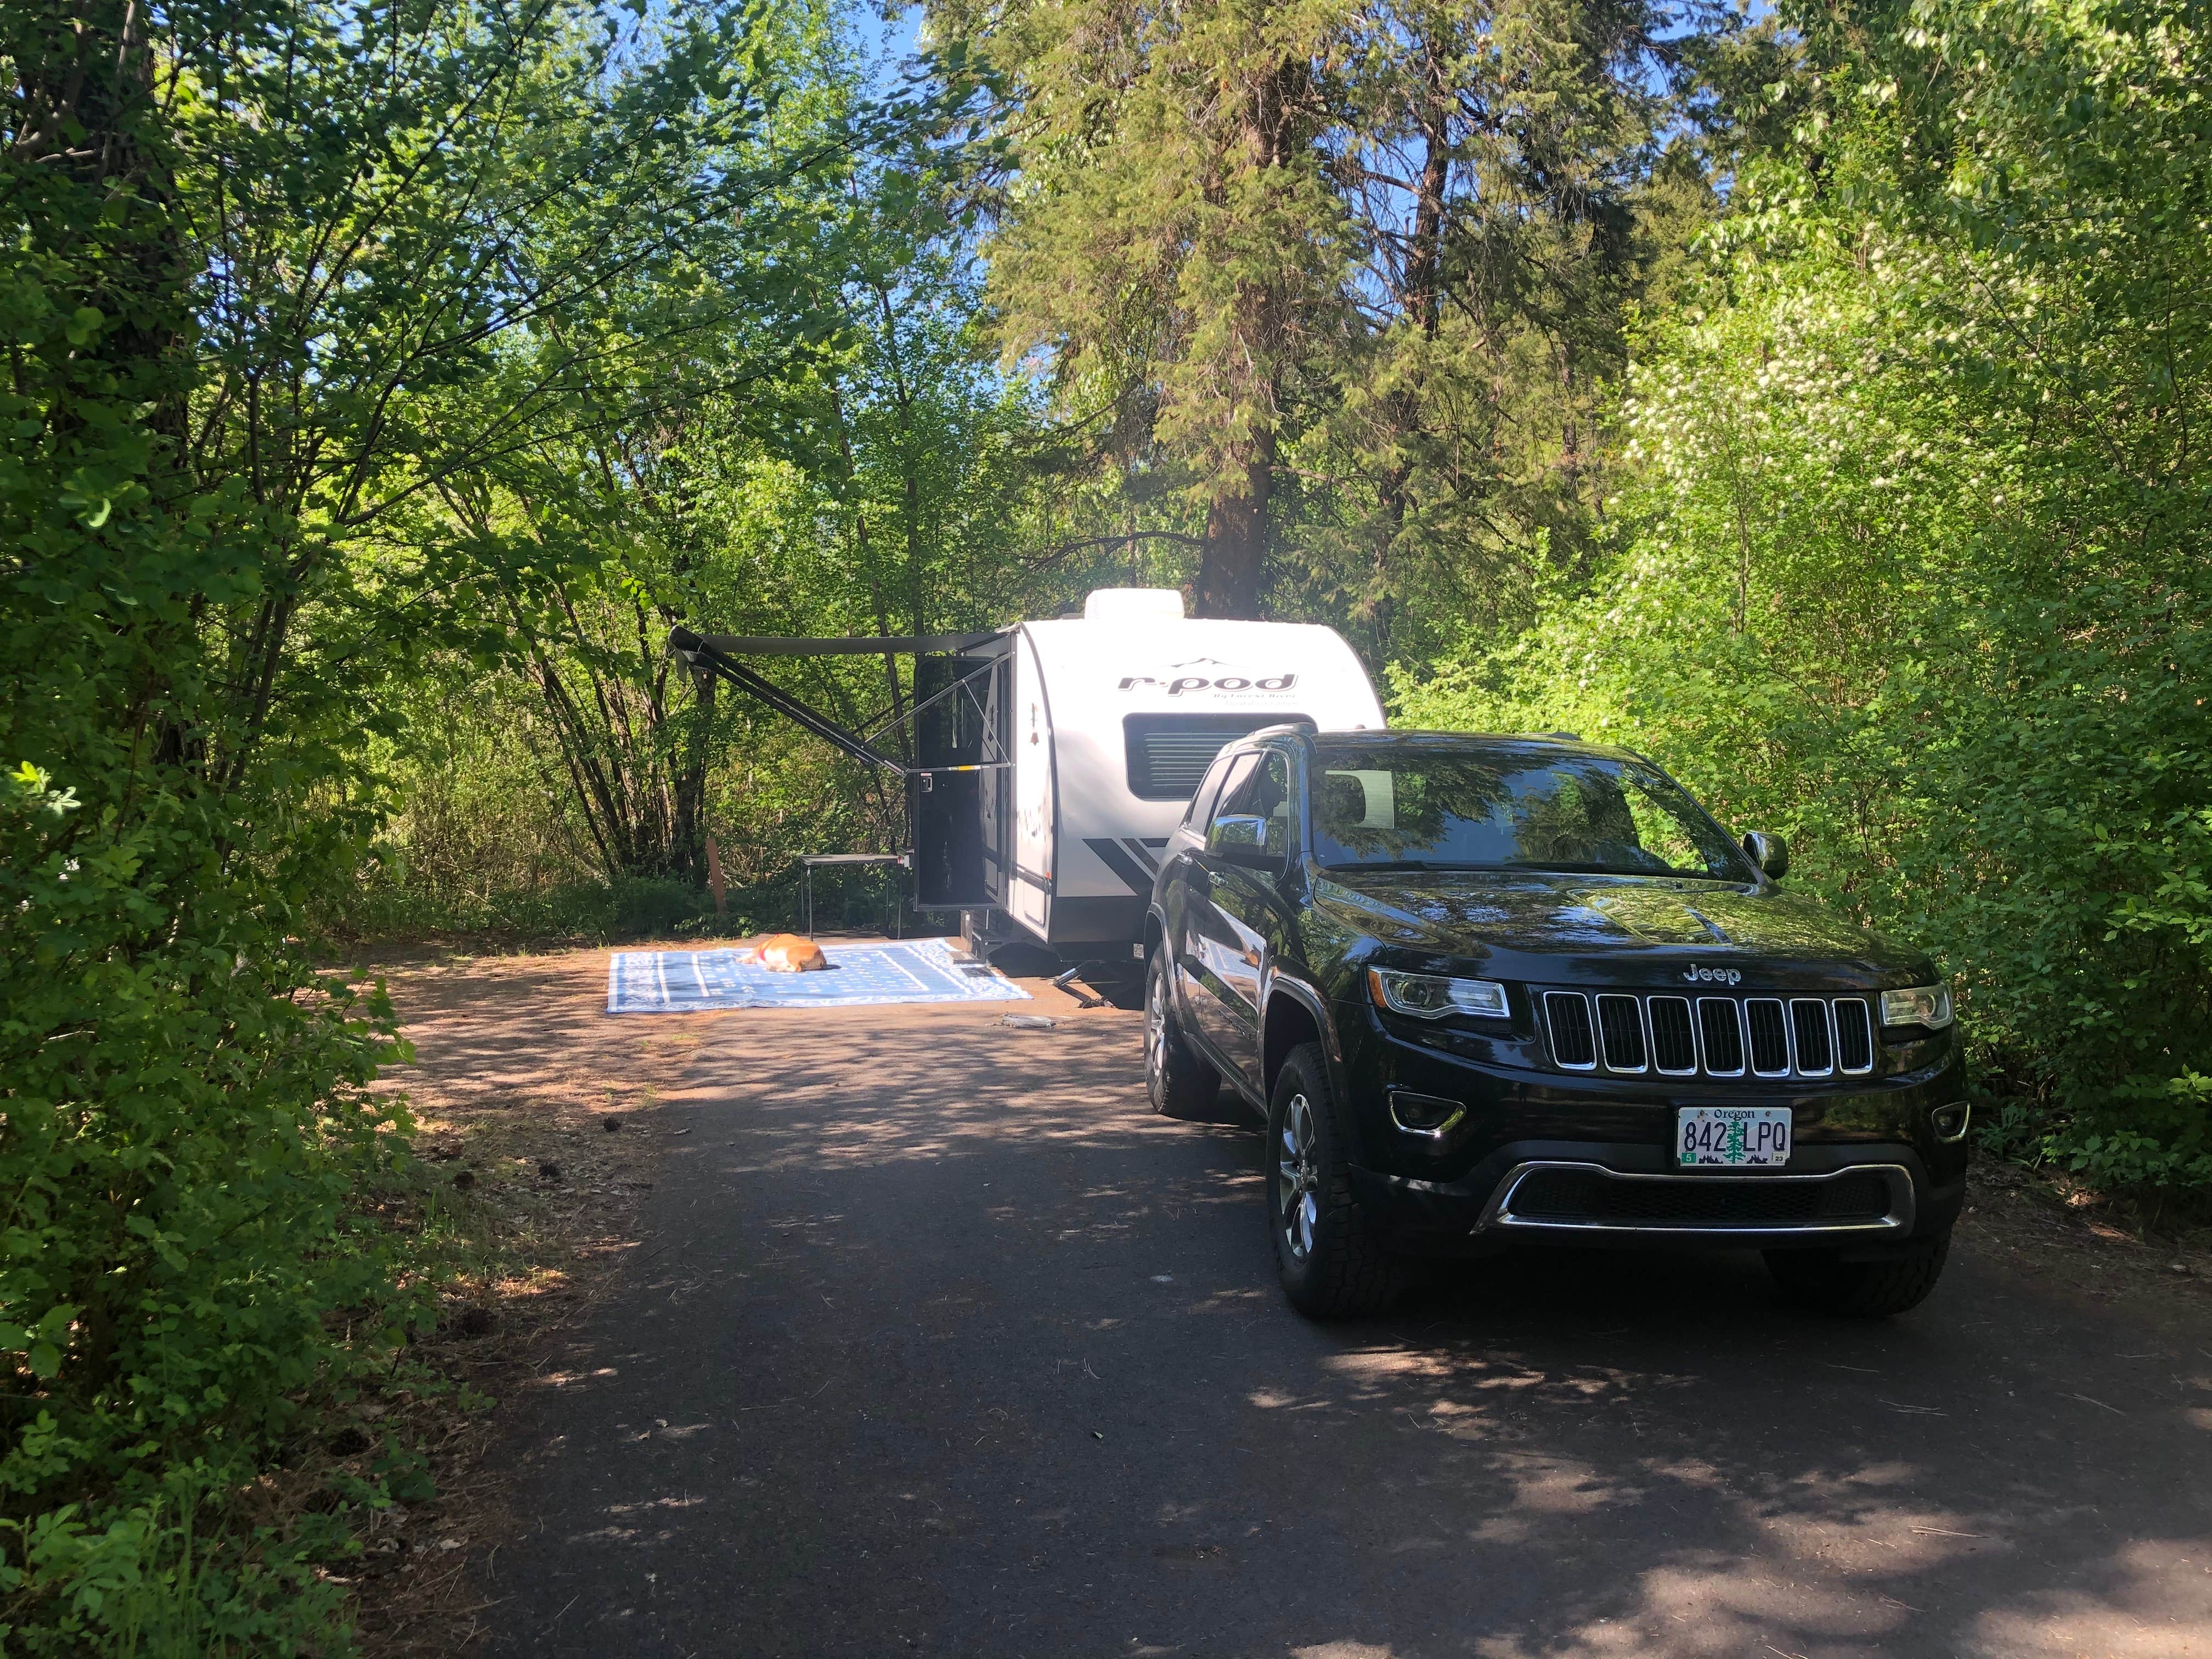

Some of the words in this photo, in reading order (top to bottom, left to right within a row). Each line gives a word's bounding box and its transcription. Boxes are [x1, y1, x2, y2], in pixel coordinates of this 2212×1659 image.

[1683, 963, 1741, 985] Jeep
[1714, 1109, 1756, 1121] Oregon
[1684, 1121, 1727, 1152] 842
[1743, 1121, 1785, 1152] LPQ
[1686, 1154, 1692, 1162] 5
